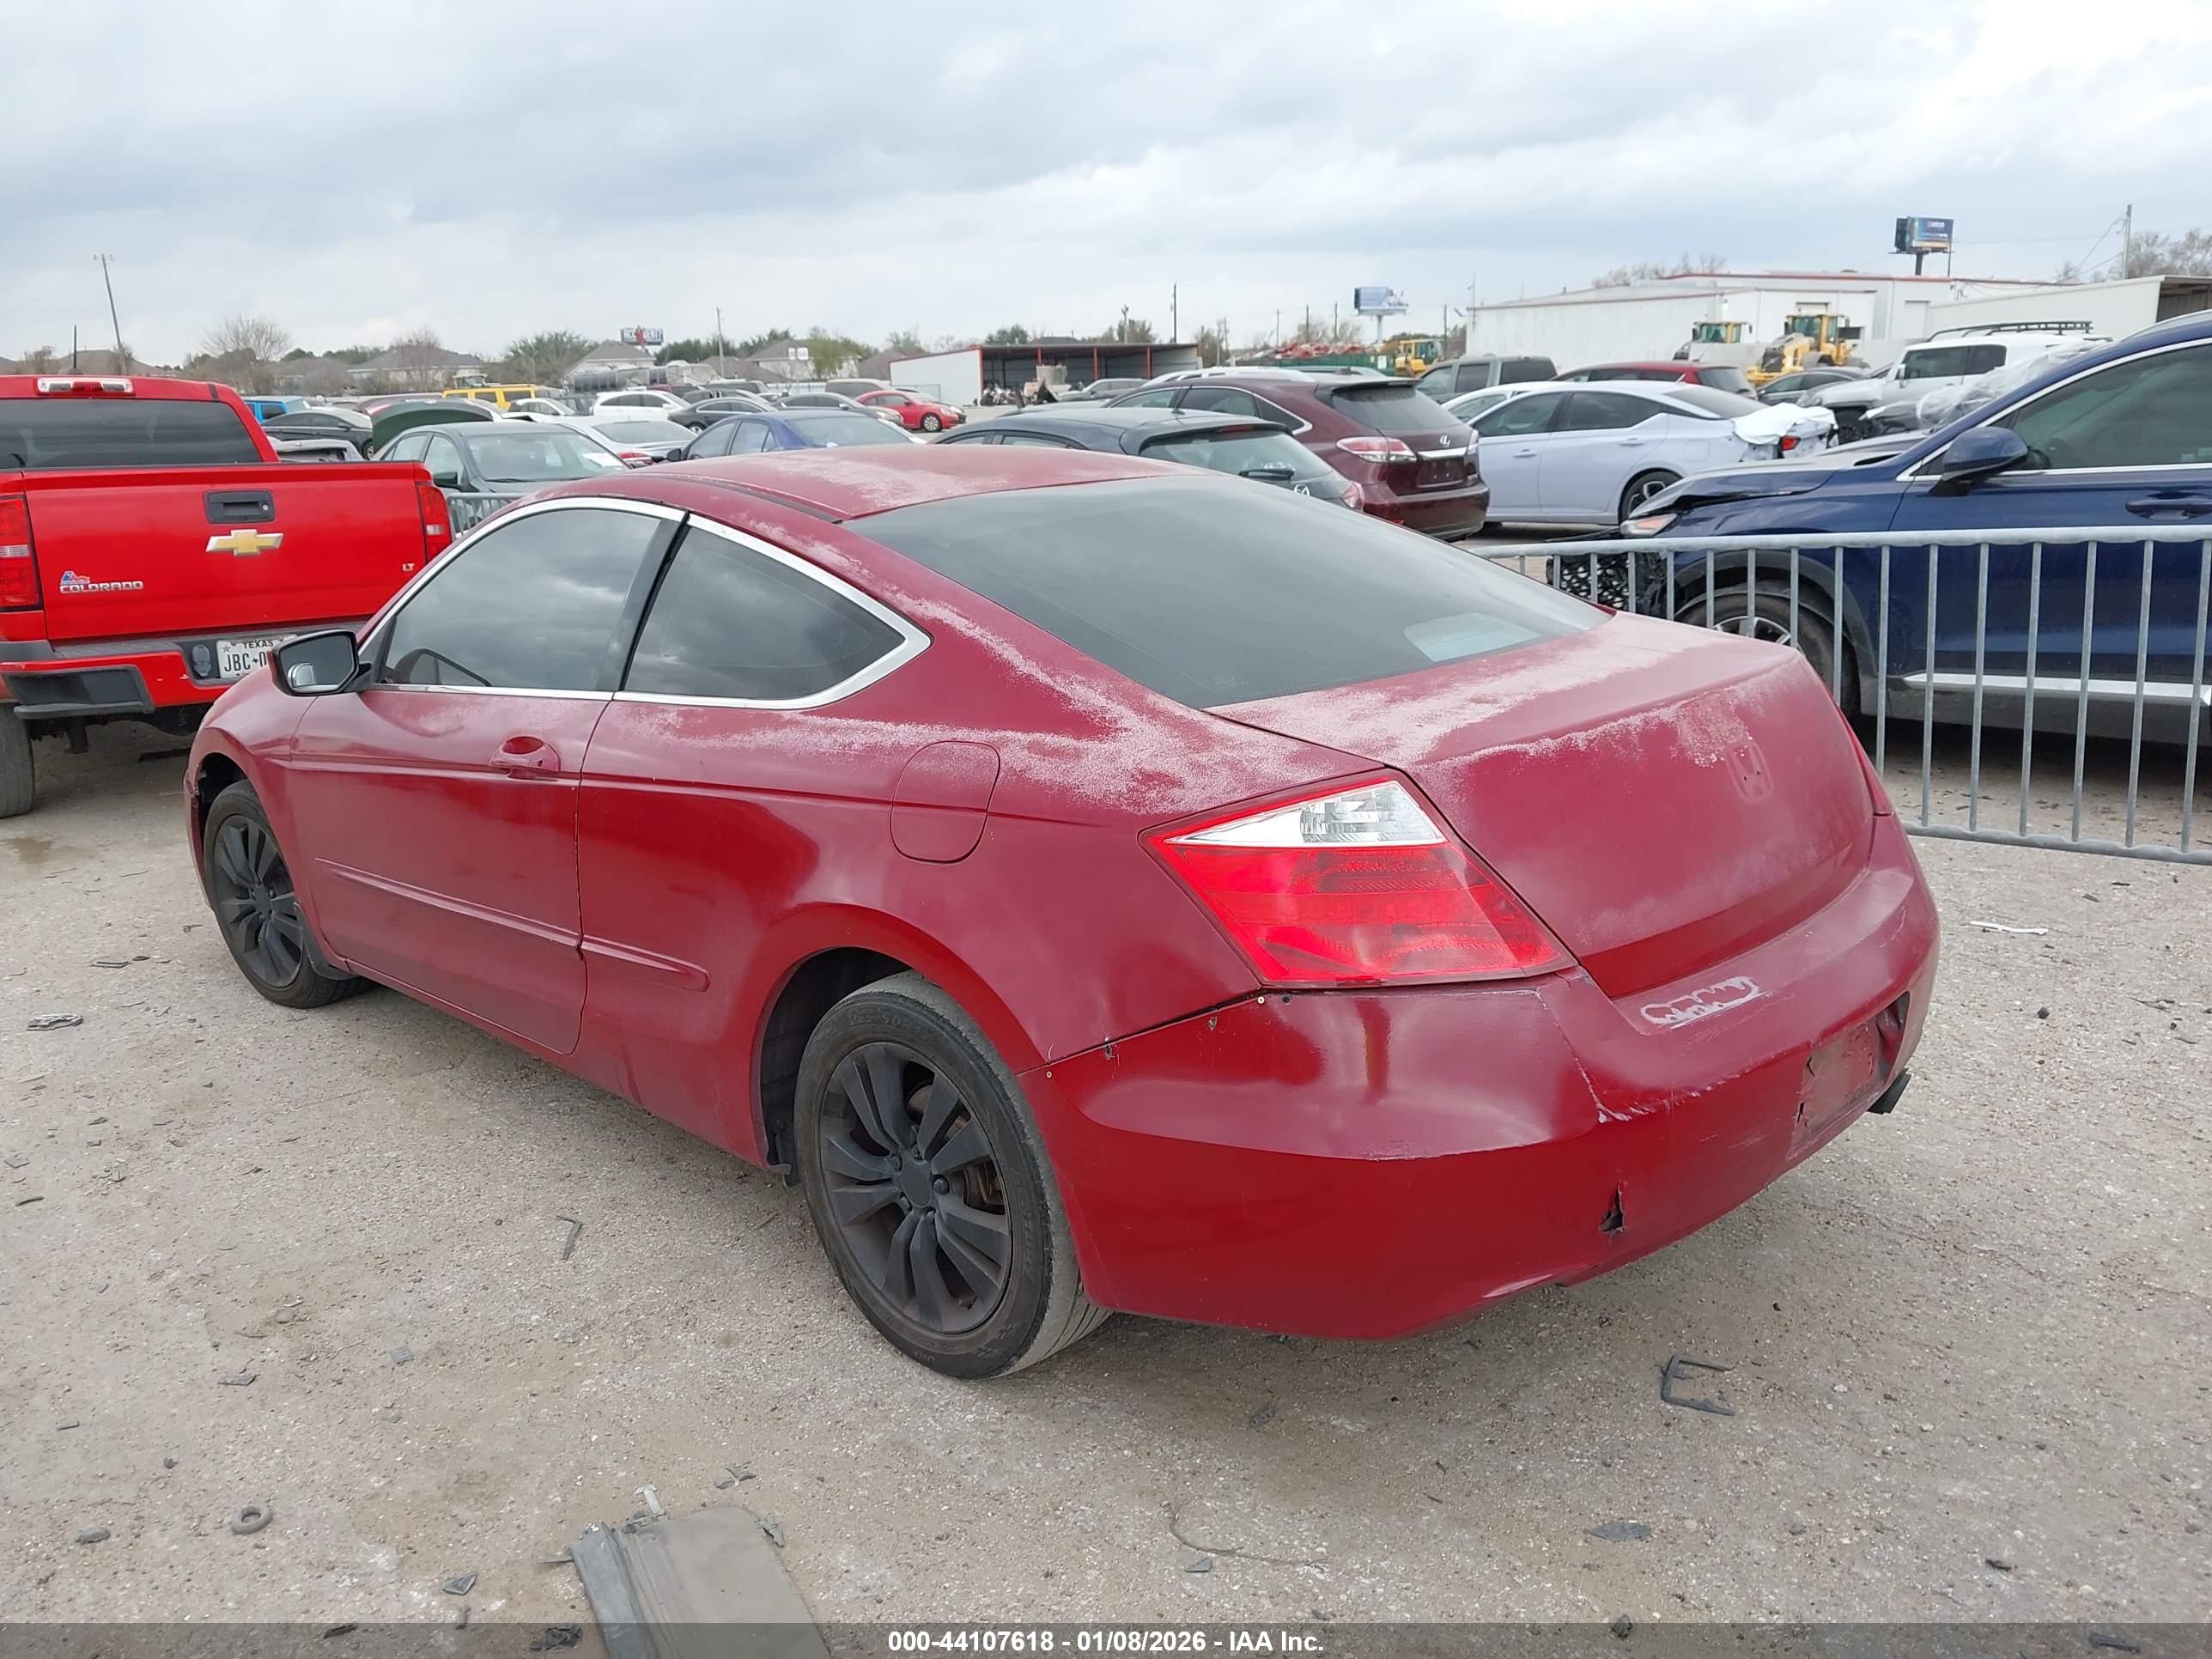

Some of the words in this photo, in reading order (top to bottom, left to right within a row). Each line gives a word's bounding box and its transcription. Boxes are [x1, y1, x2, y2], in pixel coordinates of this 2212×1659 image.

[402, 562, 415, 572] LT
[59, 580, 144, 594] COLORADO
[243, 640, 274, 649] TEXAS
[224, 653, 251, 672] JBC
